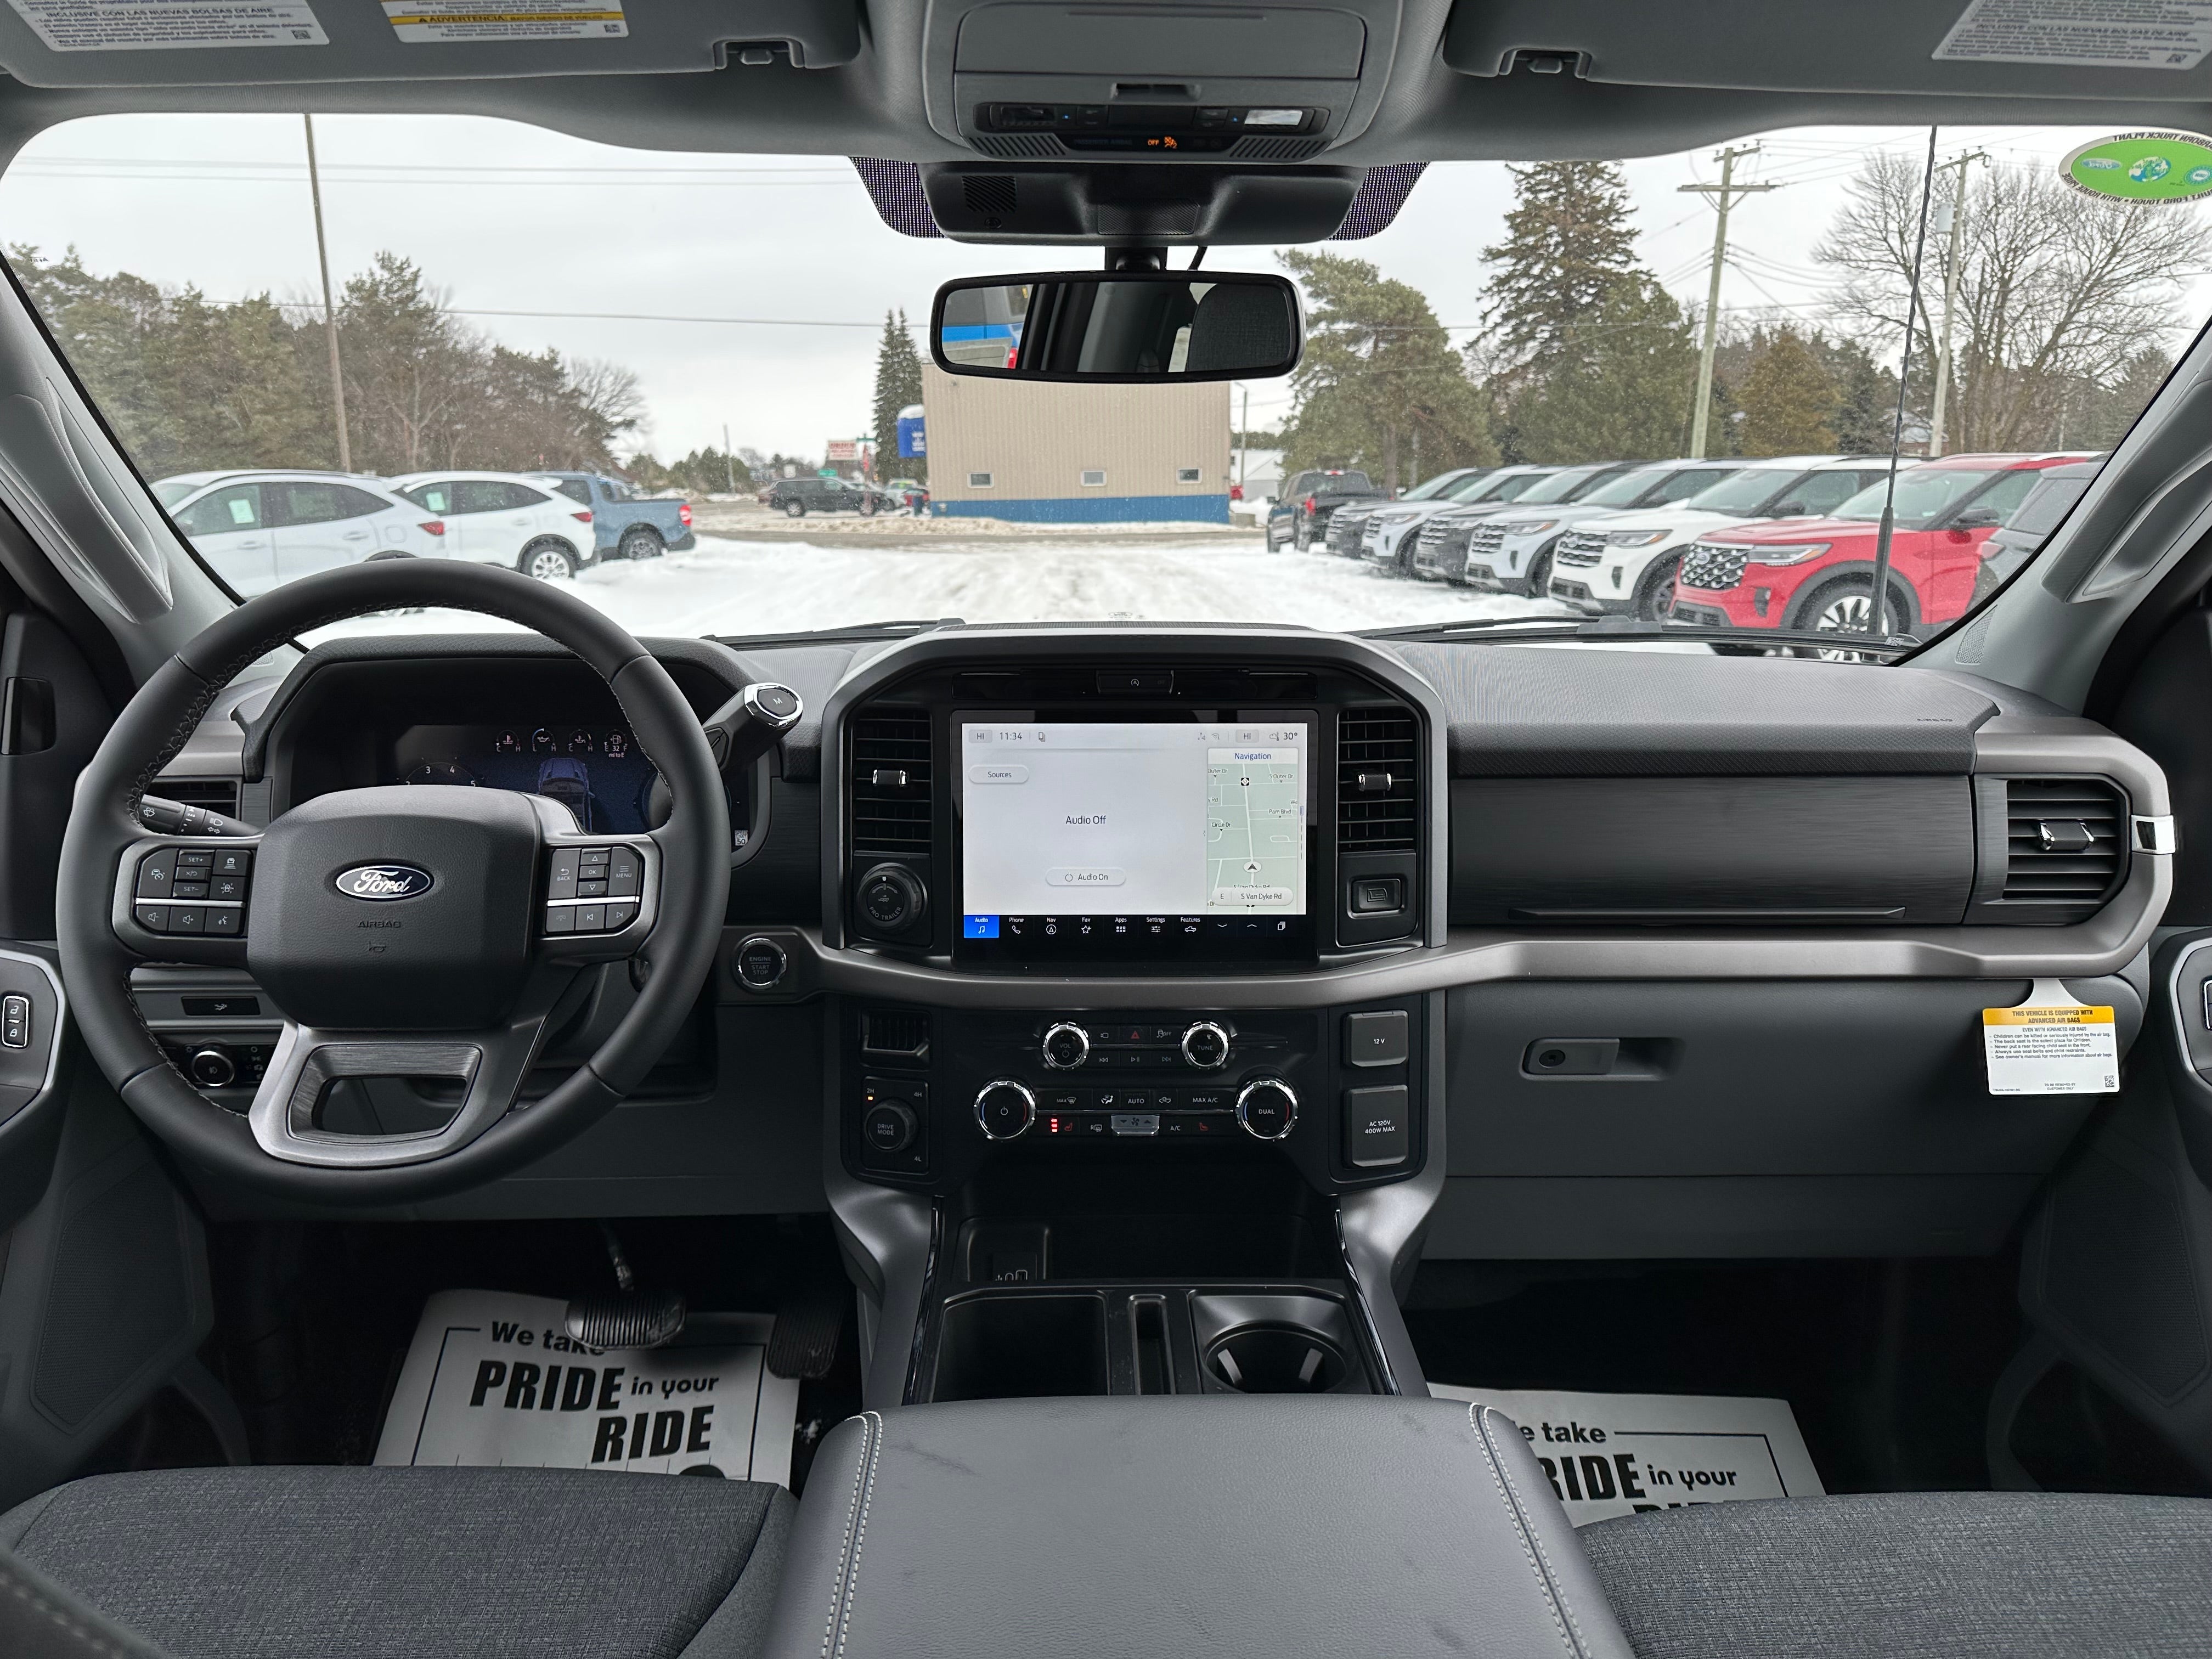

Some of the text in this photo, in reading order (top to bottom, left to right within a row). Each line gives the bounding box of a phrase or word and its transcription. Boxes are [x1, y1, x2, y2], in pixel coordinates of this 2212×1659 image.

[450, 765, 455, 774] 4
[1066, 815, 1106, 824] Audio Off
[353, 870, 413, 893] Ford
[870, 906, 901, 920] PRO TRAILER
[492, 1321, 534, 1346] We
[469, 1360, 719, 1412] PRIDE in your
[591, 1405, 714, 1464] RIDE
[1541, 1421, 1606, 1443] take
[1537, 1453, 1736, 1501] RIDE in your
